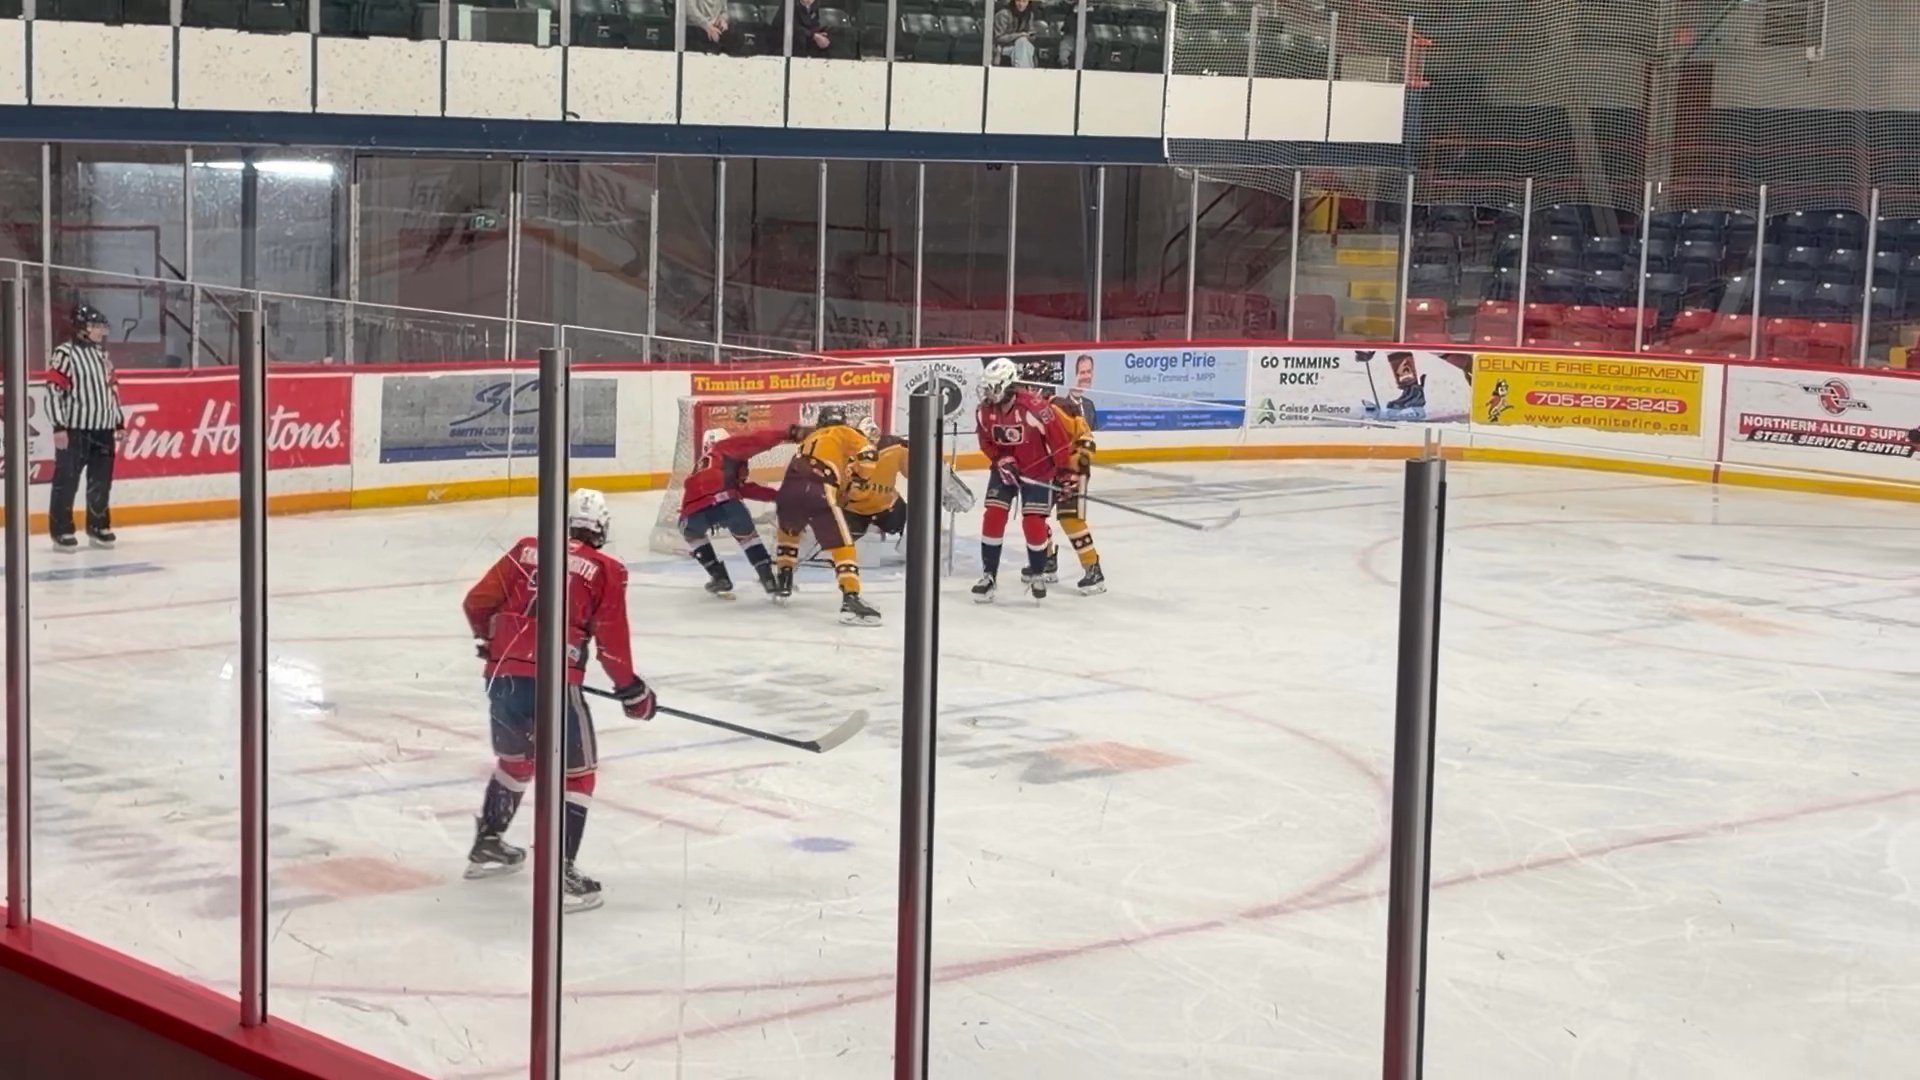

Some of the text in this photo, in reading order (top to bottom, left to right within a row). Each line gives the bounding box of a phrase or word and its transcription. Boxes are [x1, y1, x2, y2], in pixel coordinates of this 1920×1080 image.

[1124, 352, 1216, 372] George Pirie
[1260, 356, 1340, 370] GO TIMMINS
[1478, 358, 1699, 381] DELNITE FIRE EQUIPMENT
[693, 370, 891, 392] Timmins Building Centre
[1196, 373, 1216, 383] MPP
[1279, 372, 1319, 385] ROCK!
[1279, 403, 1351, 414] Caisse Alliance
[115, 399, 341, 460] Tim Hotons
[1524, 413, 1689, 432] www.delnitefire.ca
[1743, 415, 1817, 431] NORTHERN
[1820, 423, 1866, 437] ALLIED
[449, 427, 484, 438] SMITH
[1753, 430, 1912, 456] STEEL SERVICE CENTRE
